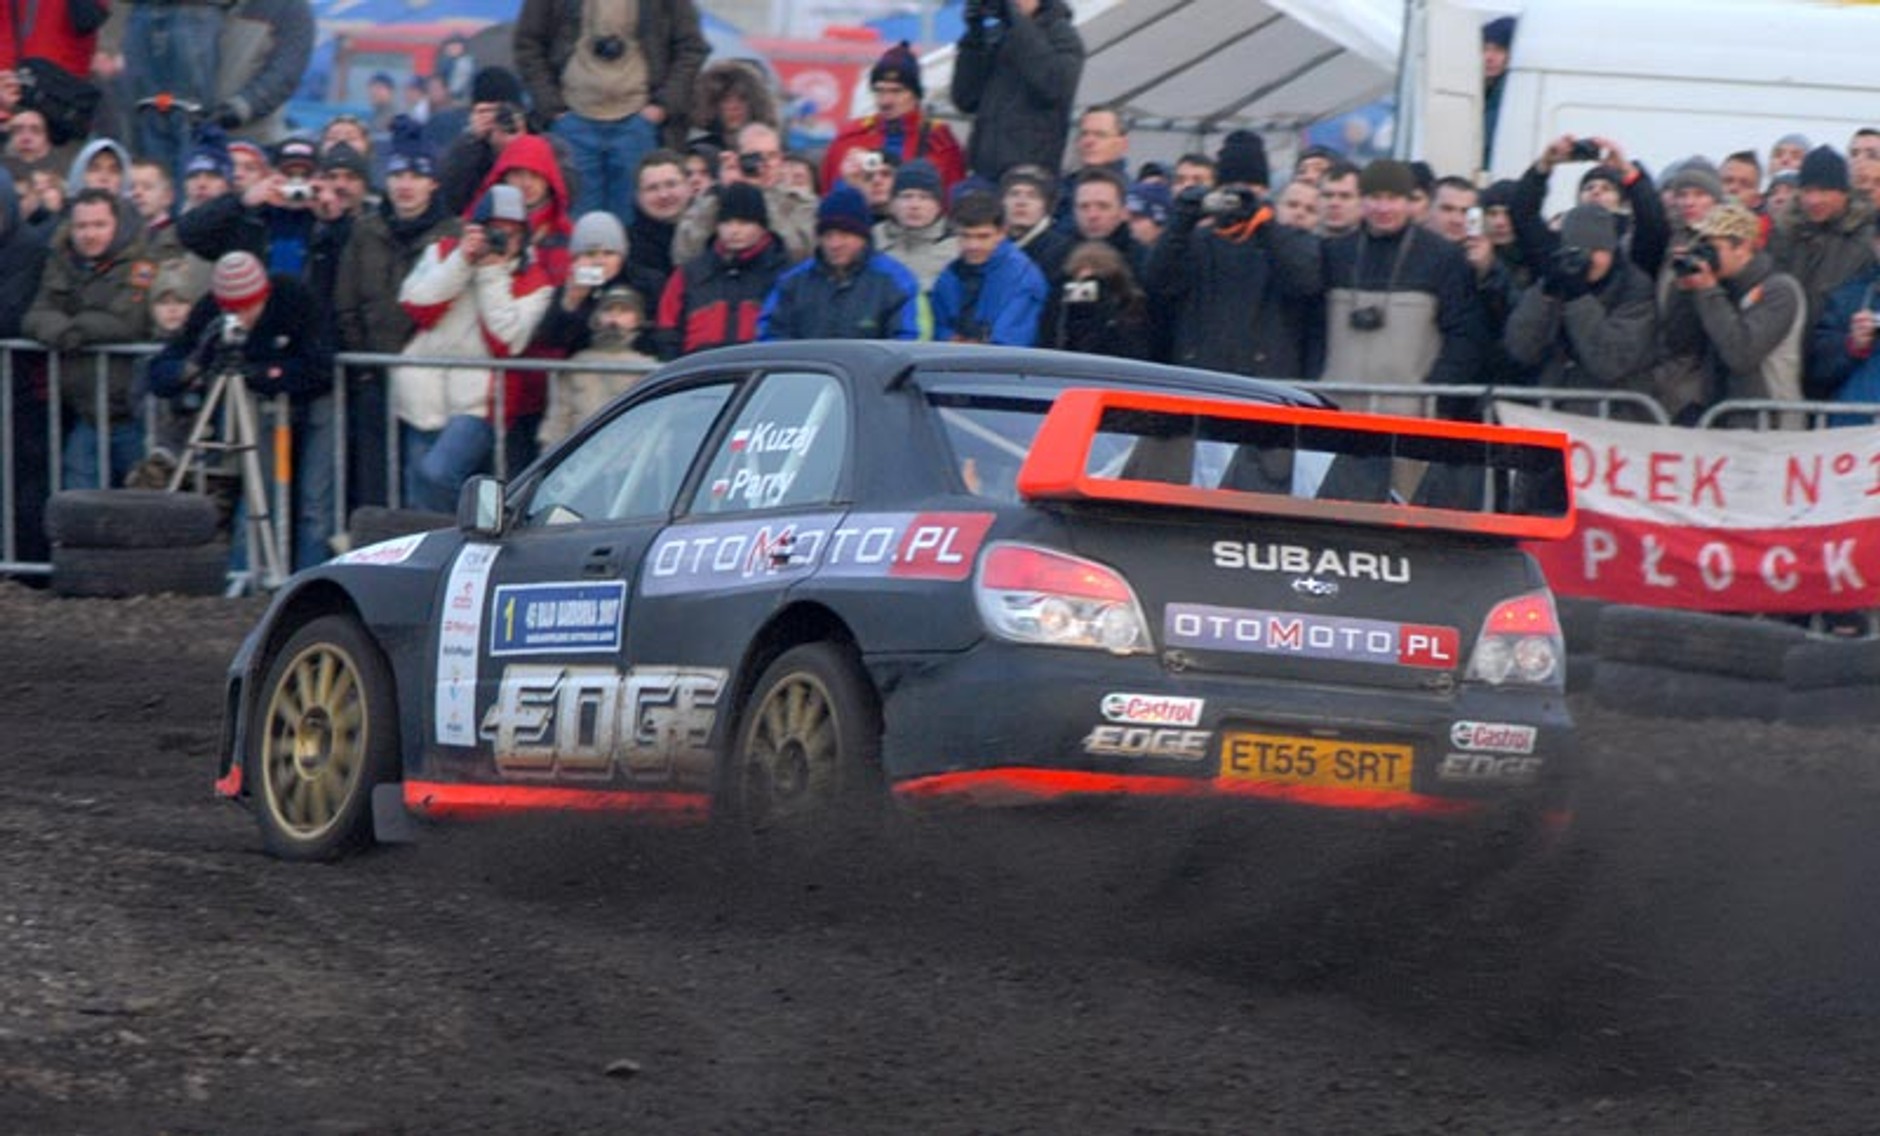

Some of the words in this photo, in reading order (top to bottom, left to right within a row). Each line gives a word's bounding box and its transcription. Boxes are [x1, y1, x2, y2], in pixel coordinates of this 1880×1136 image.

[746, 421, 819, 456] Kuzaj
[727, 468, 797, 506] Parry
[1212, 540, 1411, 583] SUBARU
[1583, 527, 1867, 592] PŁOCK
[504, 597, 516, 642] 1
[1174, 612, 1450, 661] OTOMOTO.PL
[480, 664, 729, 781] EDGE
[1126, 697, 1197, 722] Castrol
[1081, 725, 1213, 760] EDGE
[1472, 725, 1532, 750] Castrol
[1229, 740, 1317, 778] ET55
[1334, 746, 1403, 783] SRT
